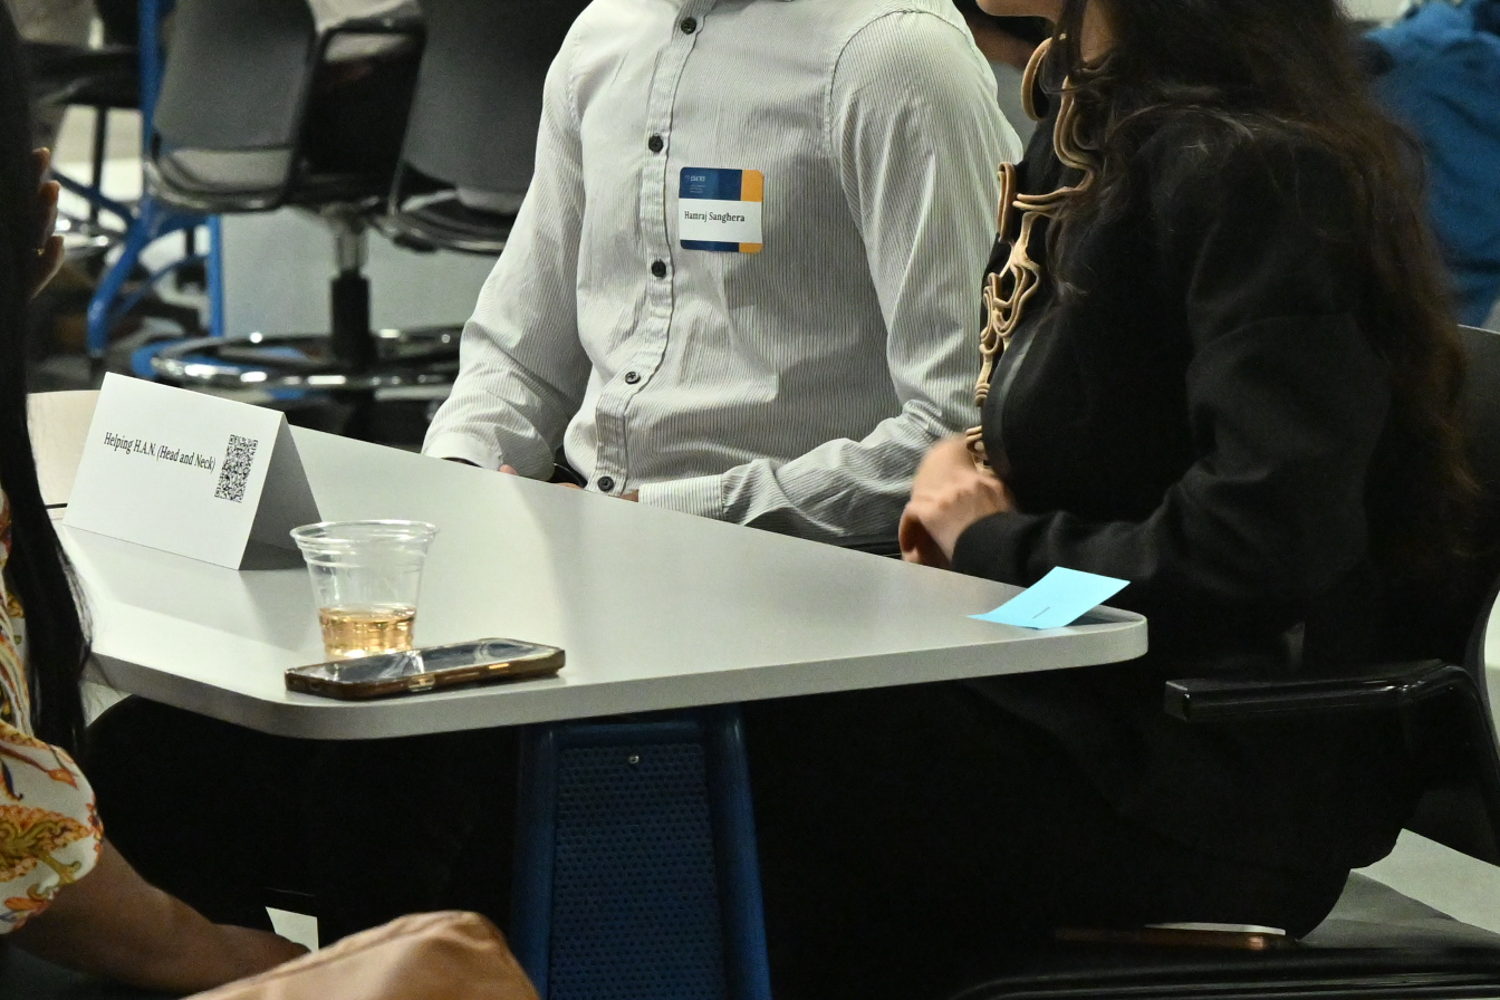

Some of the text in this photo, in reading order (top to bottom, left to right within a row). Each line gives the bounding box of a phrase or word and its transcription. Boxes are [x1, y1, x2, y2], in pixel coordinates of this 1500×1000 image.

[709, 211, 745, 223] Sanghera
[103, 431, 216, 474] Helping H.A.N. (Head and Neck)
